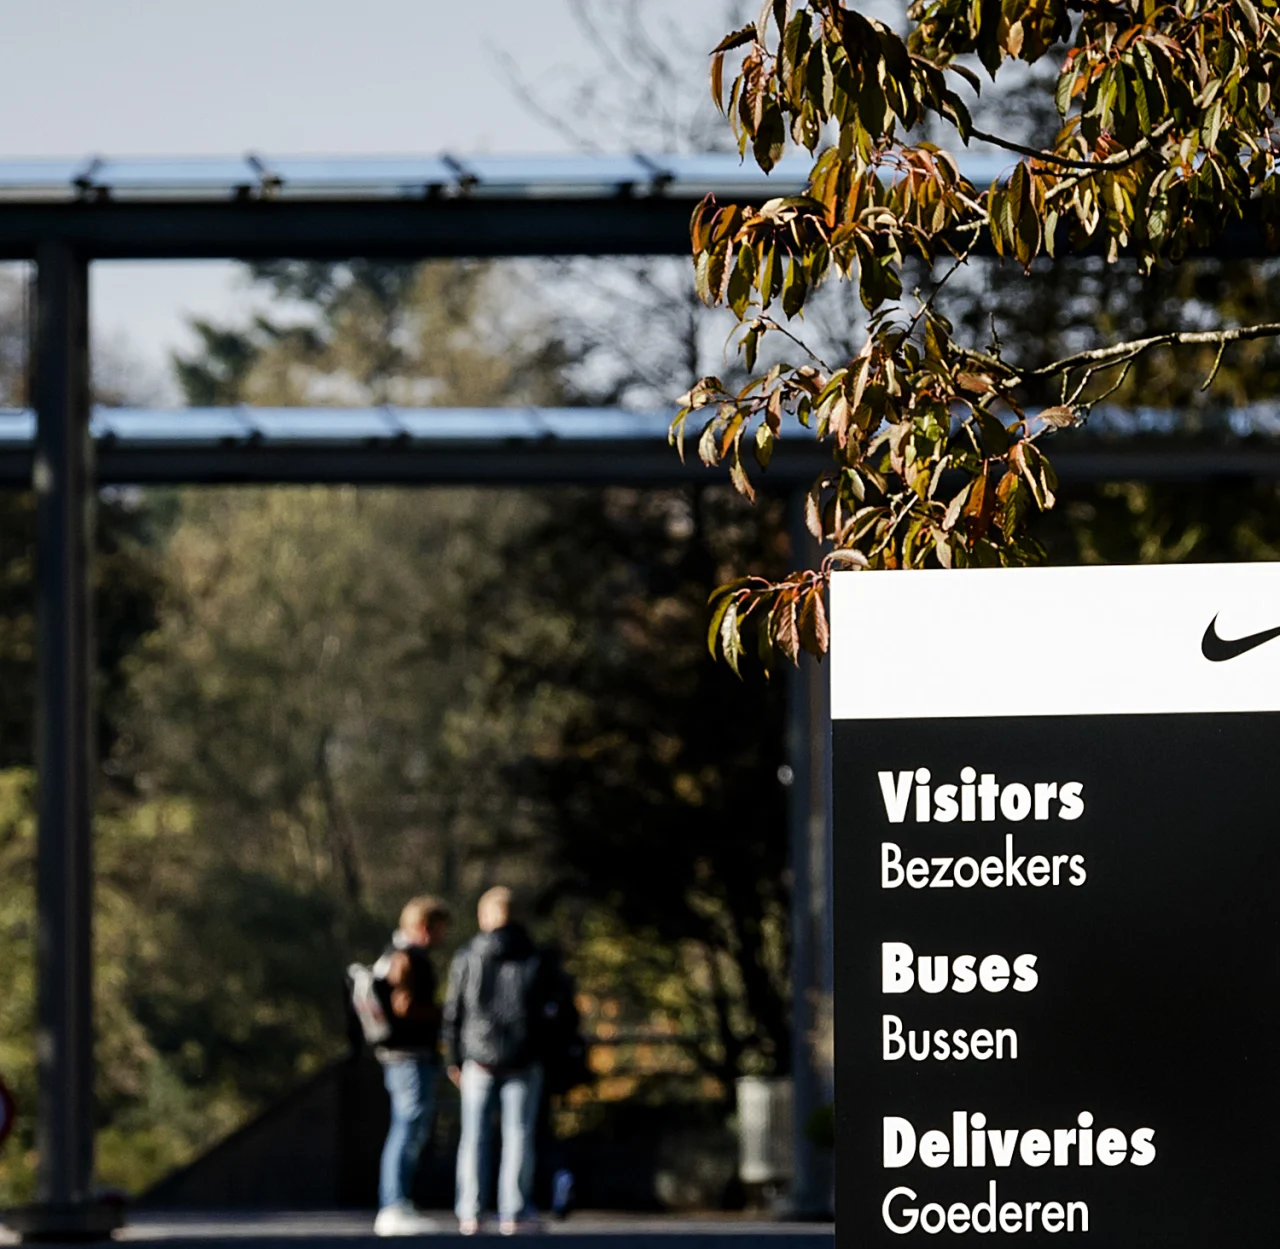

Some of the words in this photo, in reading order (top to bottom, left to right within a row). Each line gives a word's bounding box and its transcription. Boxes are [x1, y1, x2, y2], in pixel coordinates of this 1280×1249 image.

[878, 767, 1084, 823] Visitors
[881, 834, 1086, 888] Bezoekers
[881, 942, 1038, 993] Buses
[882, 1015, 1018, 1060] Bussen
[882, 1111, 1156, 1168] Deliveries
[882, 1180, 1088, 1234] Goederen
